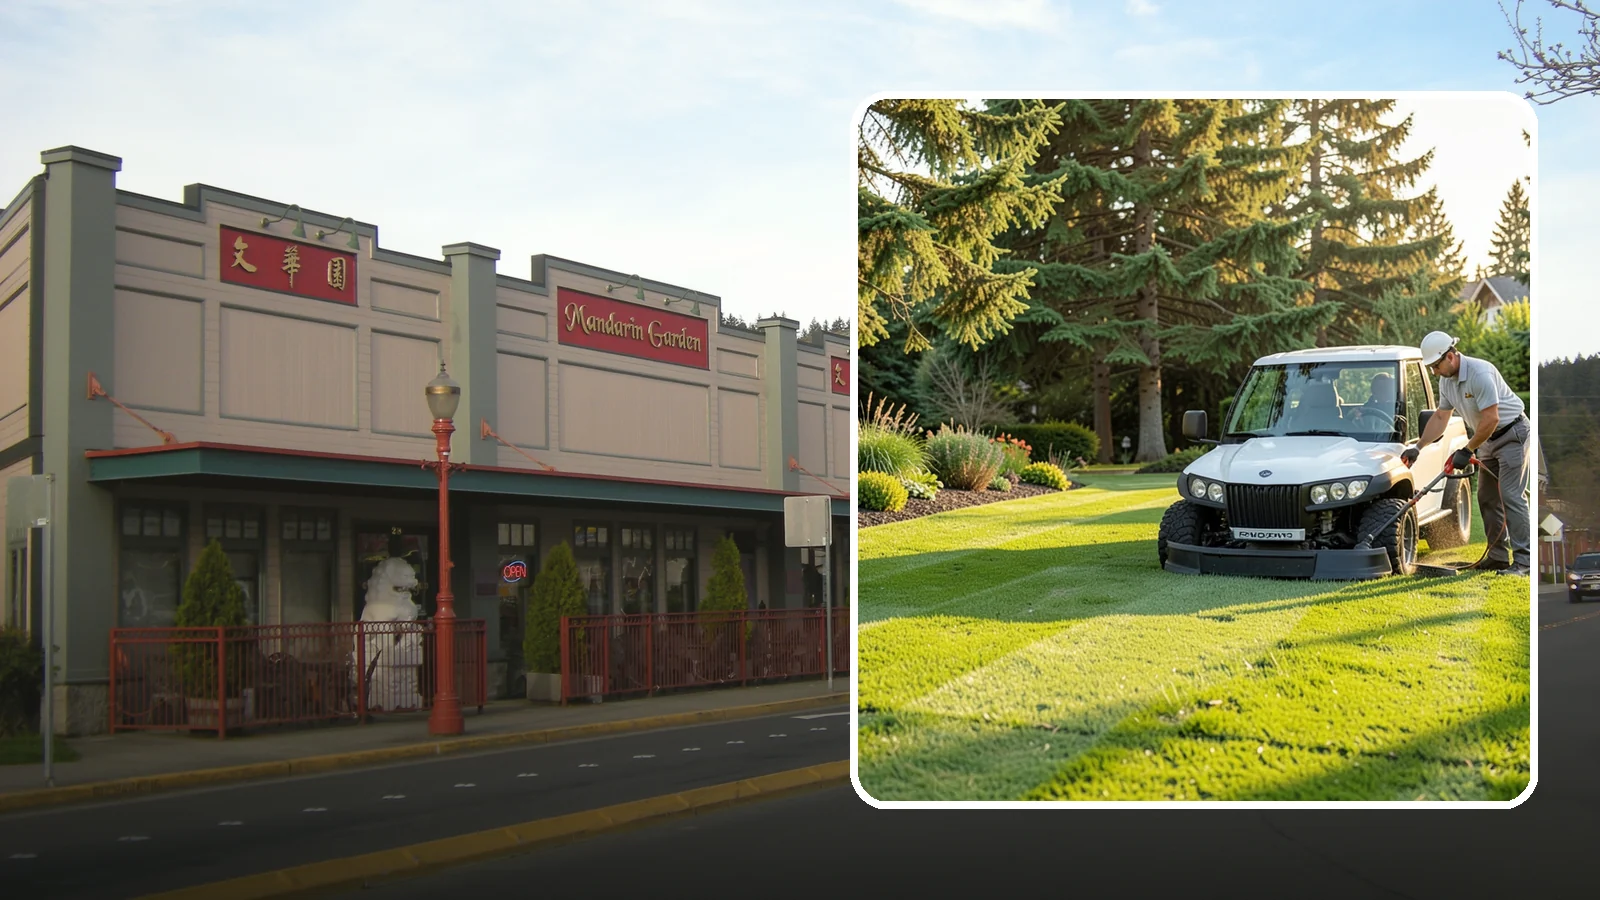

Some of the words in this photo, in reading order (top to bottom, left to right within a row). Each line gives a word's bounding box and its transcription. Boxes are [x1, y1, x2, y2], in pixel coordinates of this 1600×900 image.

[564, 302, 644, 341] Mandarin
[648, 320, 702, 352] Garden
[503, 565, 527, 578] OPEN
